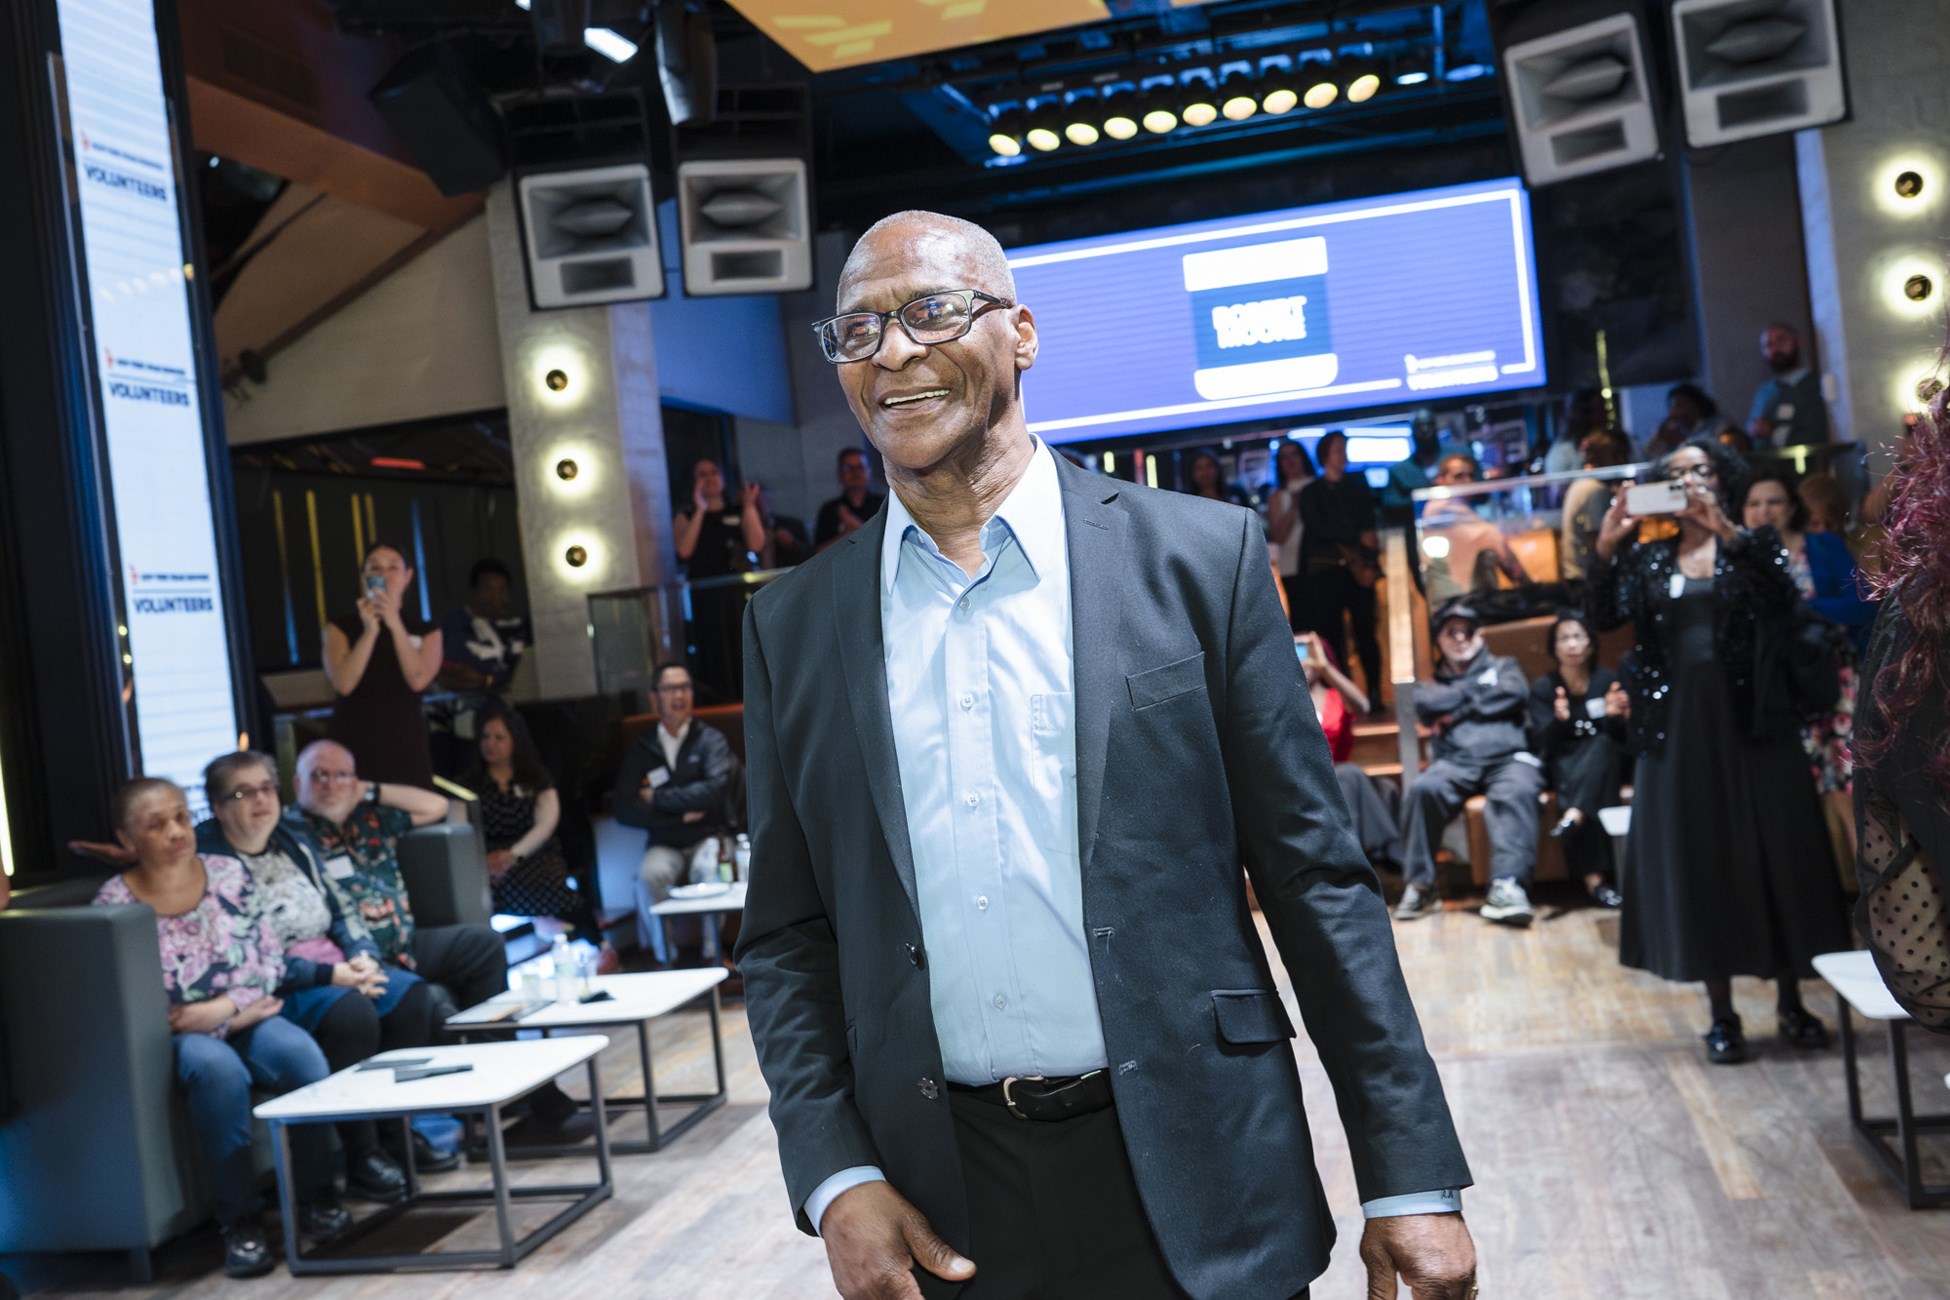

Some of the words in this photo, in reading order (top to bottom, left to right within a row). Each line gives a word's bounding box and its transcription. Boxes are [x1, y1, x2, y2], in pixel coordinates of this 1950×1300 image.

[84, 163, 167, 202] VOLUNTEERS
[108, 382, 188, 406] VOLUNTEERS
[132, 598, 213, 613] VOLUNTEERS
